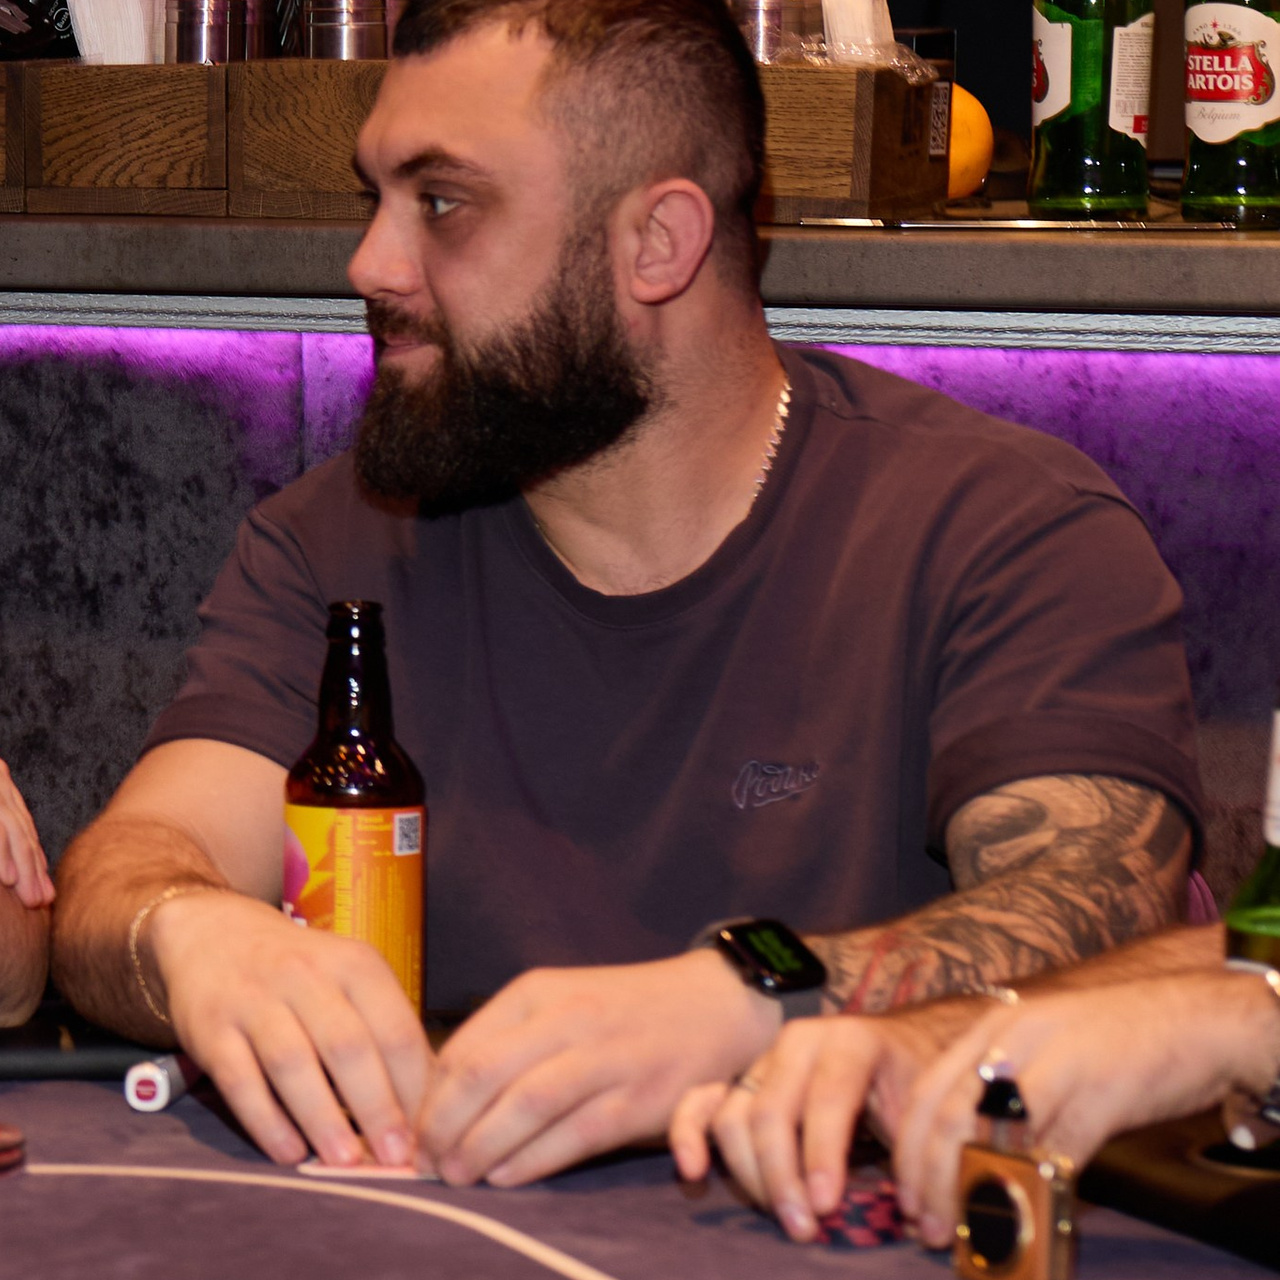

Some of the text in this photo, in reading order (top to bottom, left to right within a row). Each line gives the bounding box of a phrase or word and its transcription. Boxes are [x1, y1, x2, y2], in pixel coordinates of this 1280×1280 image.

[1187, 55, 1254, 72] STELLA
[1187, 74, 1255, 91] ARTOIS
[1194, 105, 1241, 124] Belgium
